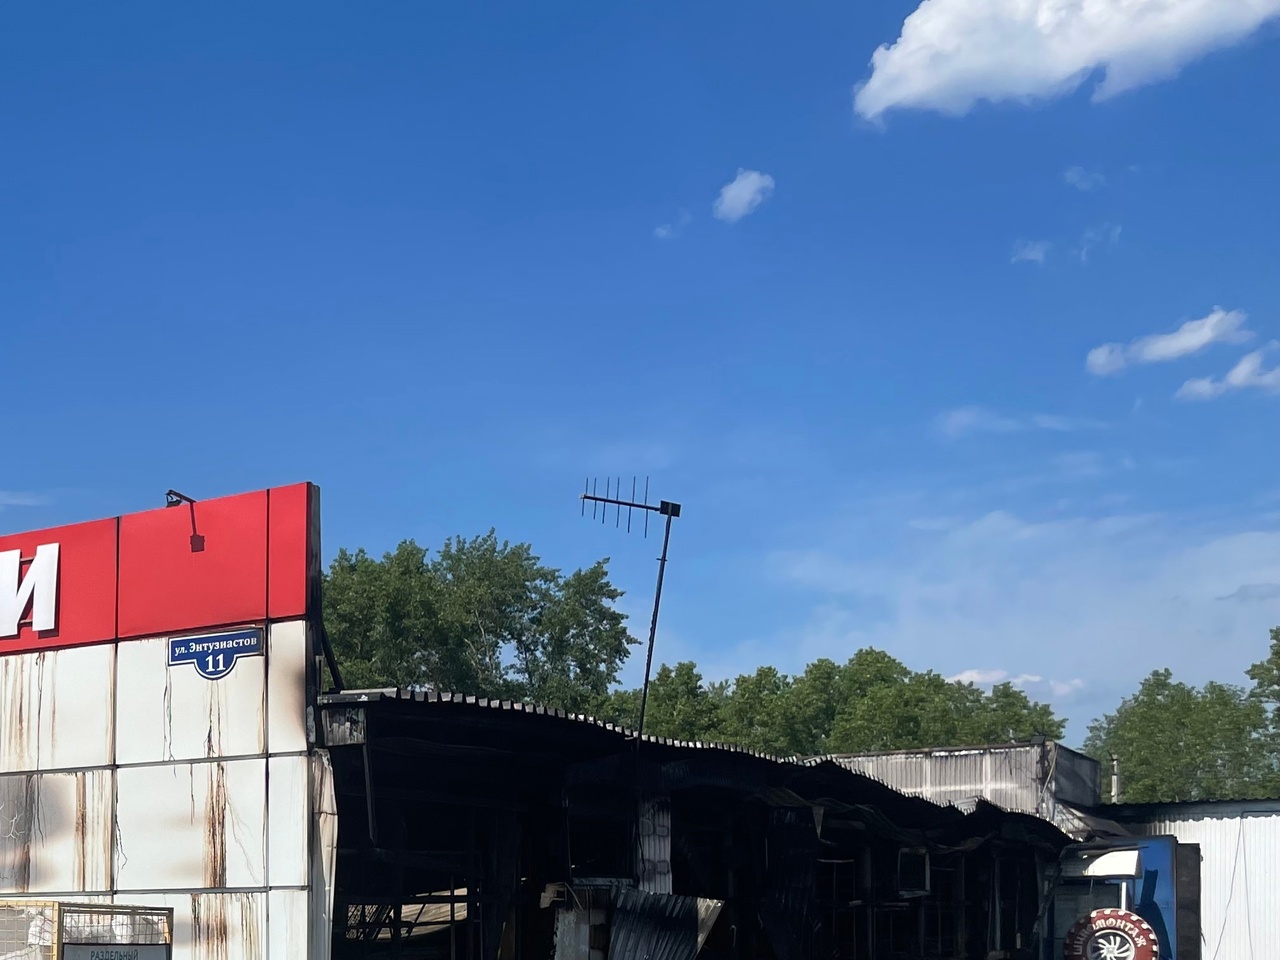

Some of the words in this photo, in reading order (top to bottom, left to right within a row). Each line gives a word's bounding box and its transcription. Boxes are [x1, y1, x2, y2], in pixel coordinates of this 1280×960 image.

[174, 646, 188, 656] ул.
[189, 637, 257, 653] Энтузиастов
[205, 653, 226, 672] 11
[1072, 917, 1147, 956] ШИНОМОНТАЖ
